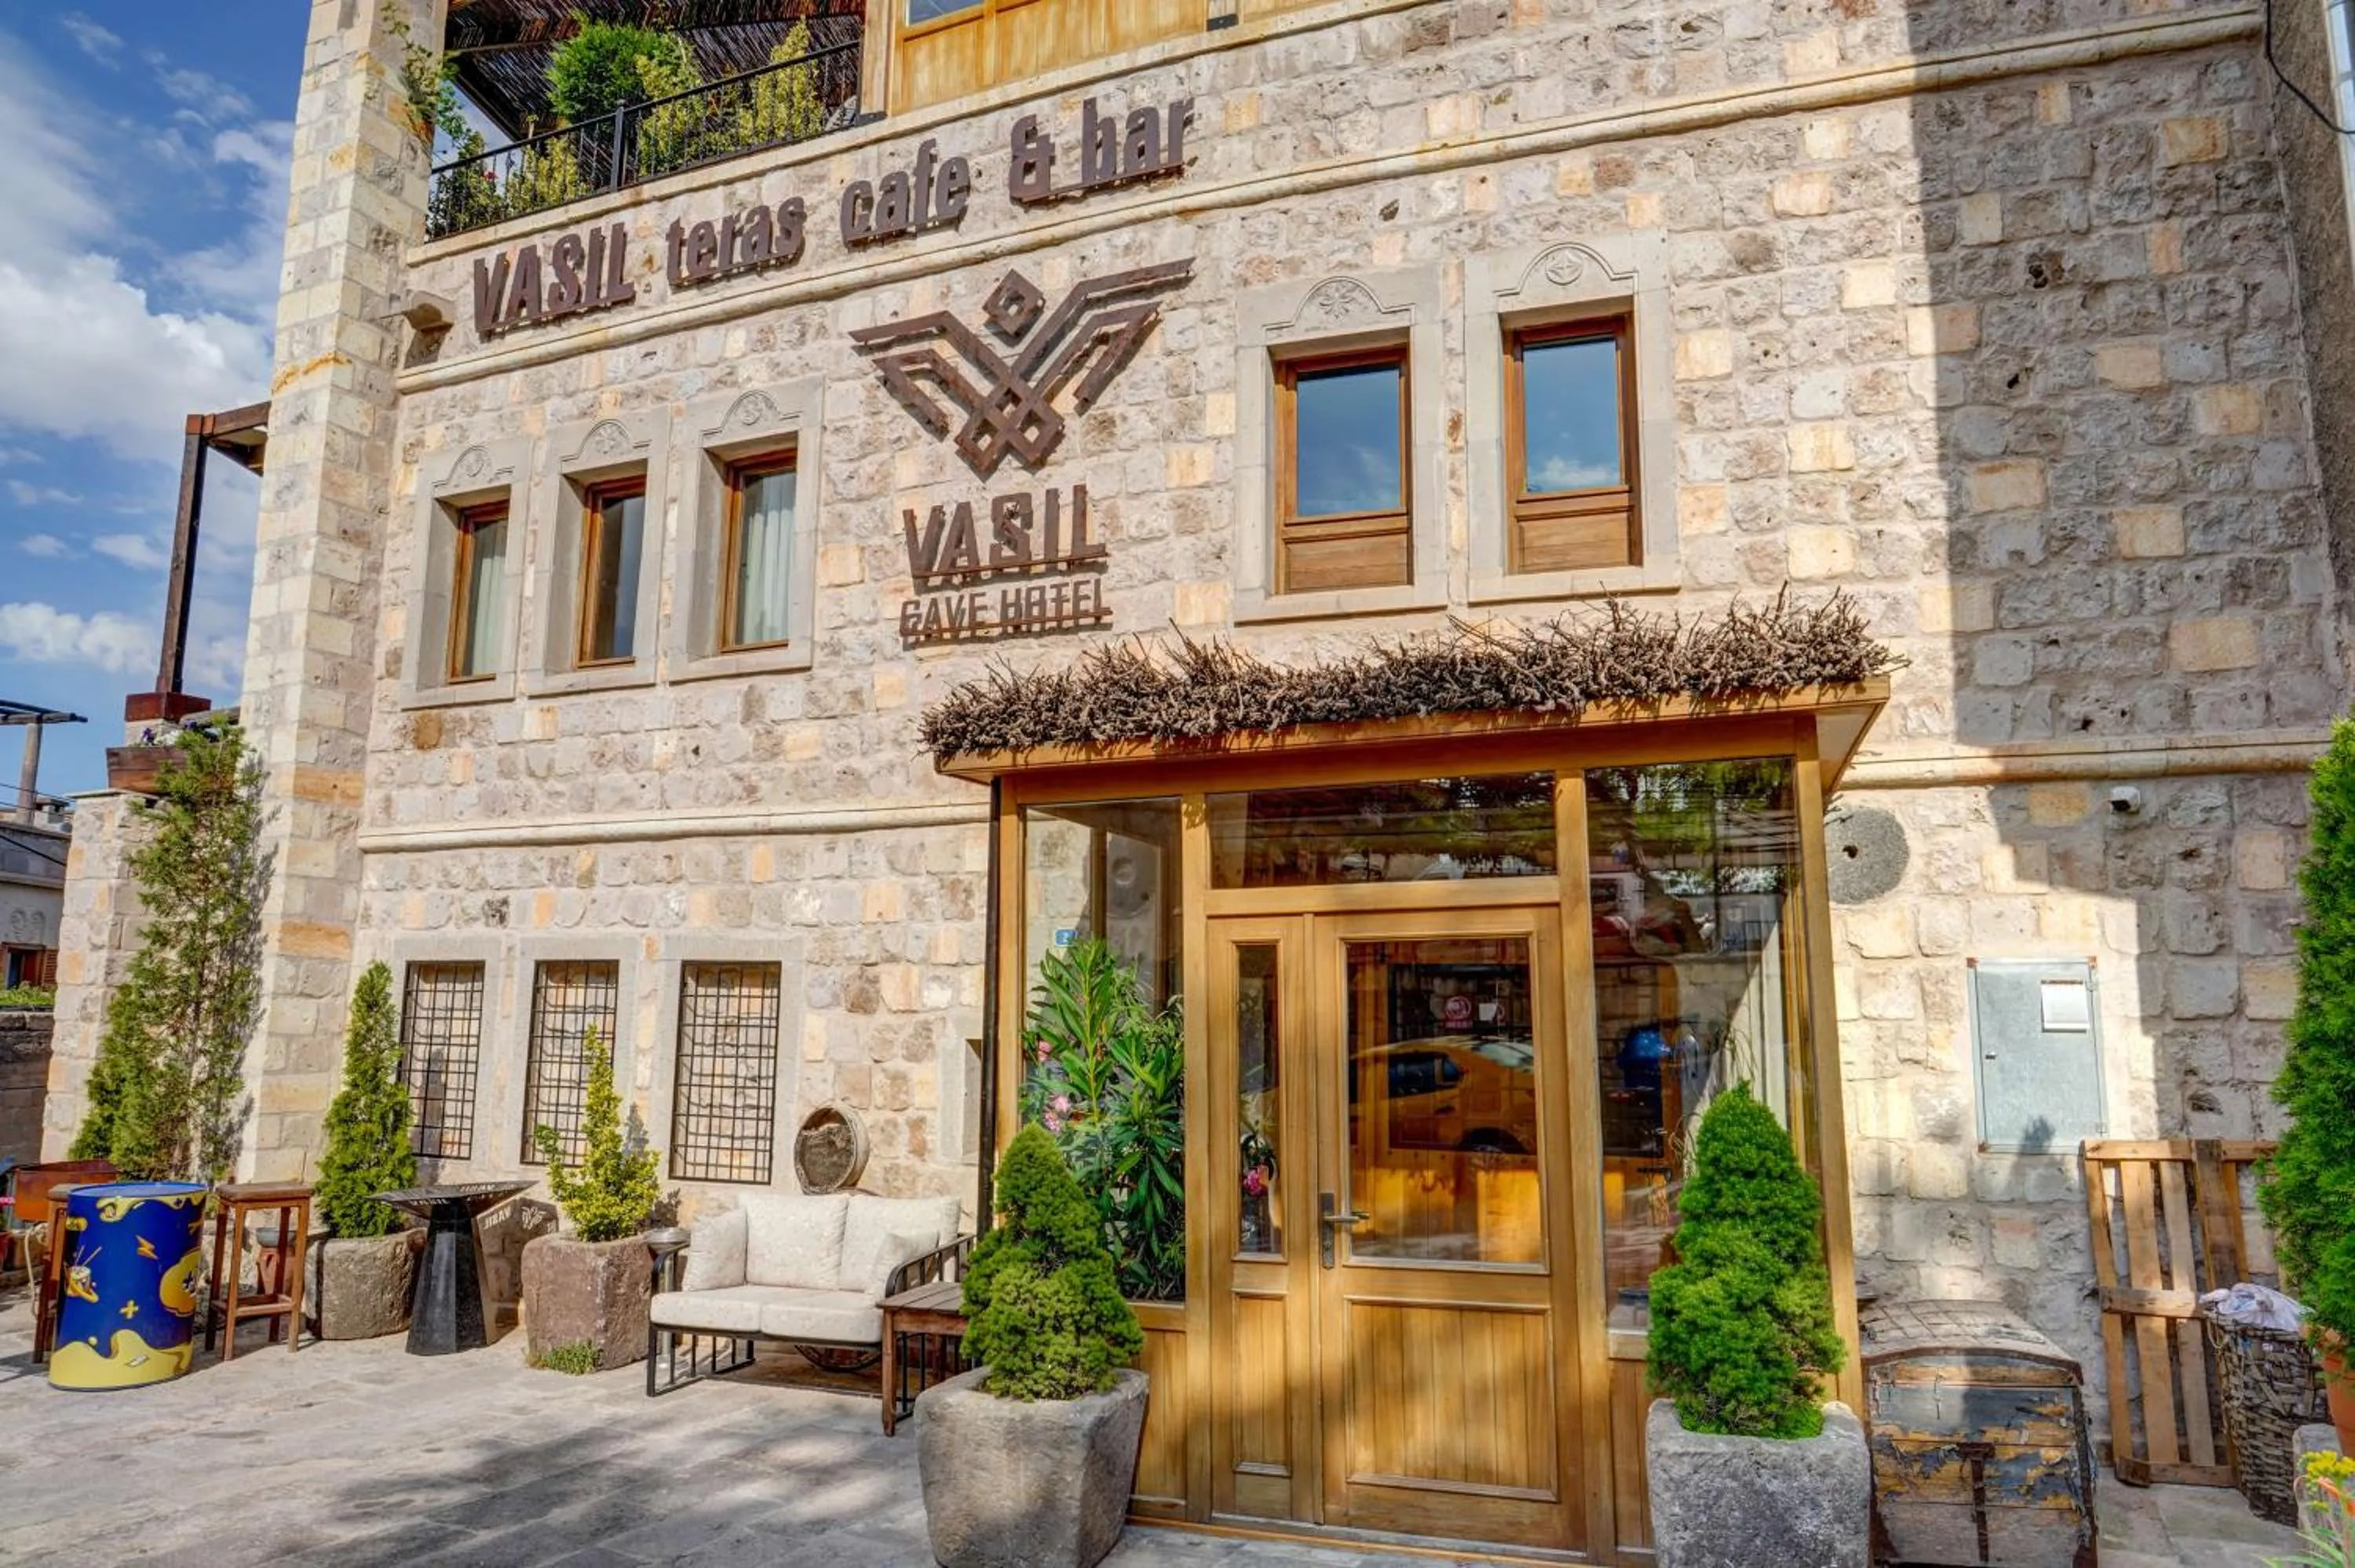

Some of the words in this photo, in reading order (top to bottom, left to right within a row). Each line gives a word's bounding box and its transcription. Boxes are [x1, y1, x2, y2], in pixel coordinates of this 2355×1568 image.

[473, 222, 634, 333] VASIL
[666, 198, 805, 286] teras
[840, 138, 969, 245] cafe
[1009, 114, 1056, 202] &
[1082, 97, 1193, 185] bar
[903, 483, 1108, 579] VASIL
[900, 591, 988, 637] CAVE
[1000, 578, 1113, 628] HOTEL
